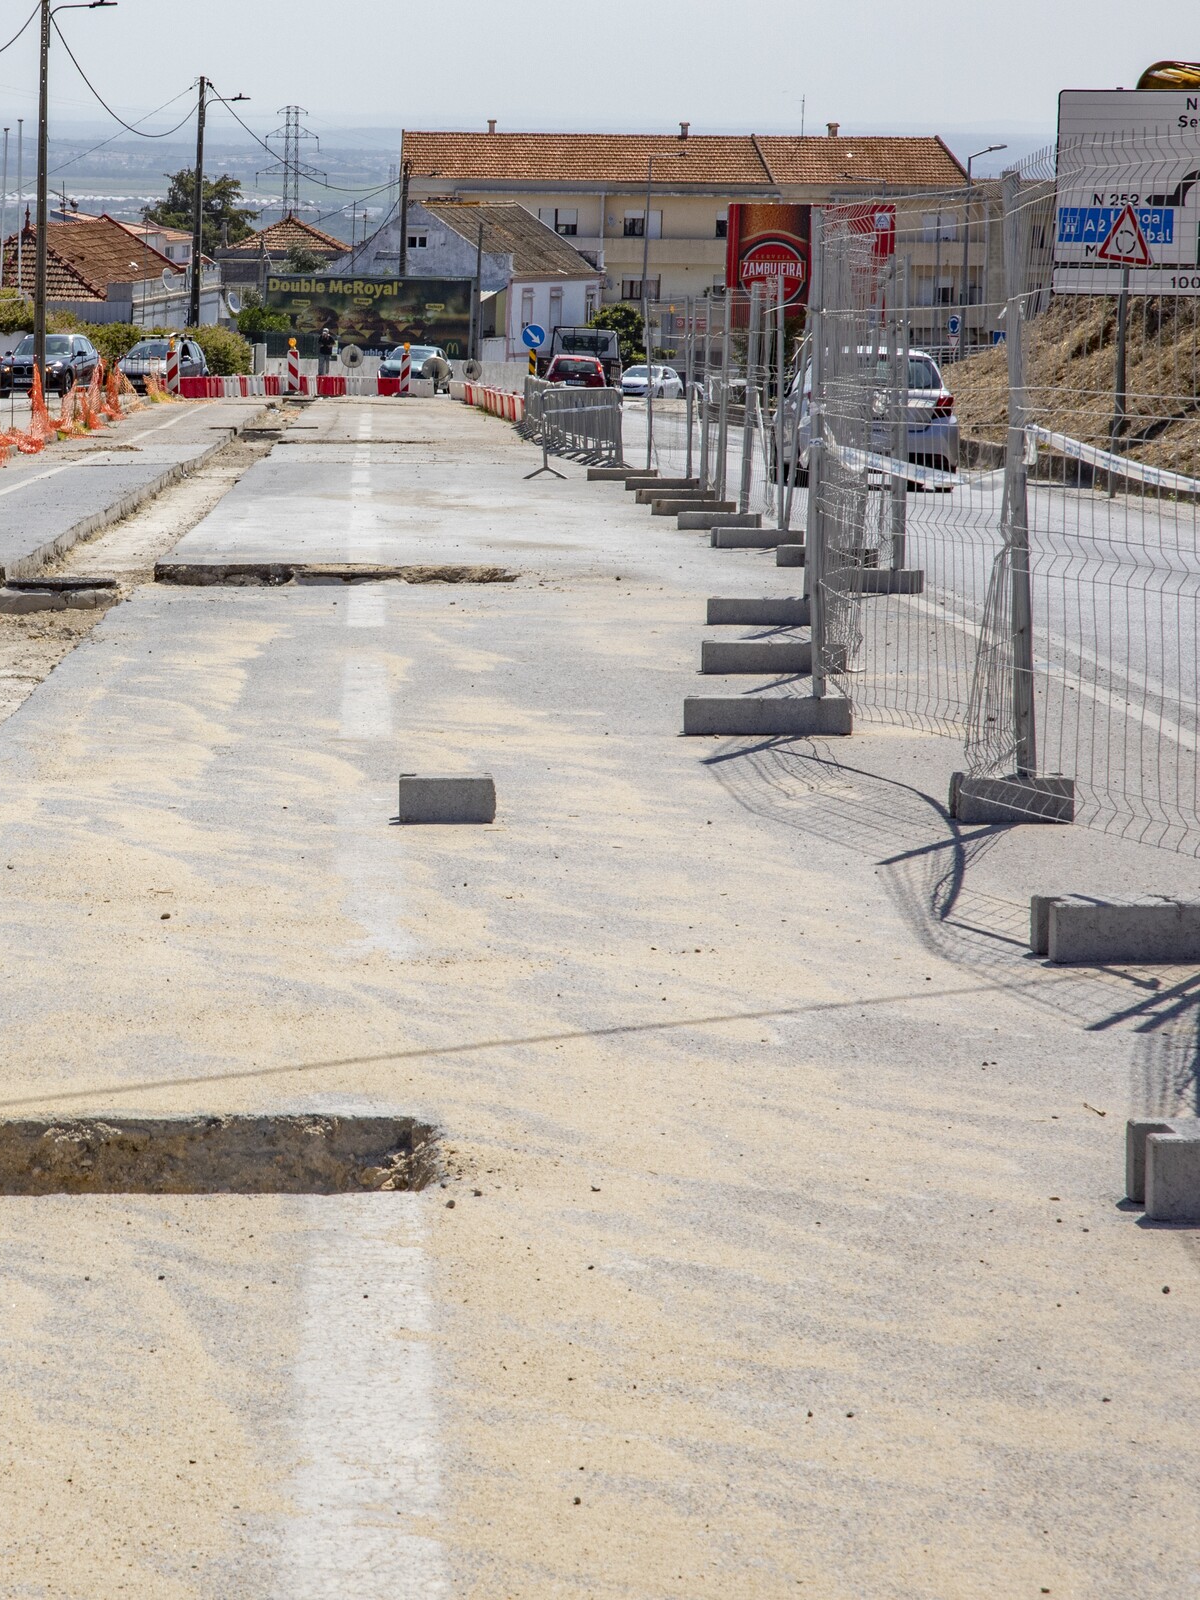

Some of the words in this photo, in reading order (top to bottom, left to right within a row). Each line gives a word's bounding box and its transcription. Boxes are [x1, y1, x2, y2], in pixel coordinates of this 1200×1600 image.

[1177, 115, 1200, 128] Se
[1093, 193, 1104, 206] N
[742, 261, 803, 279] ZAMBUJEIRA
[268, 277, 326, 294] Double
